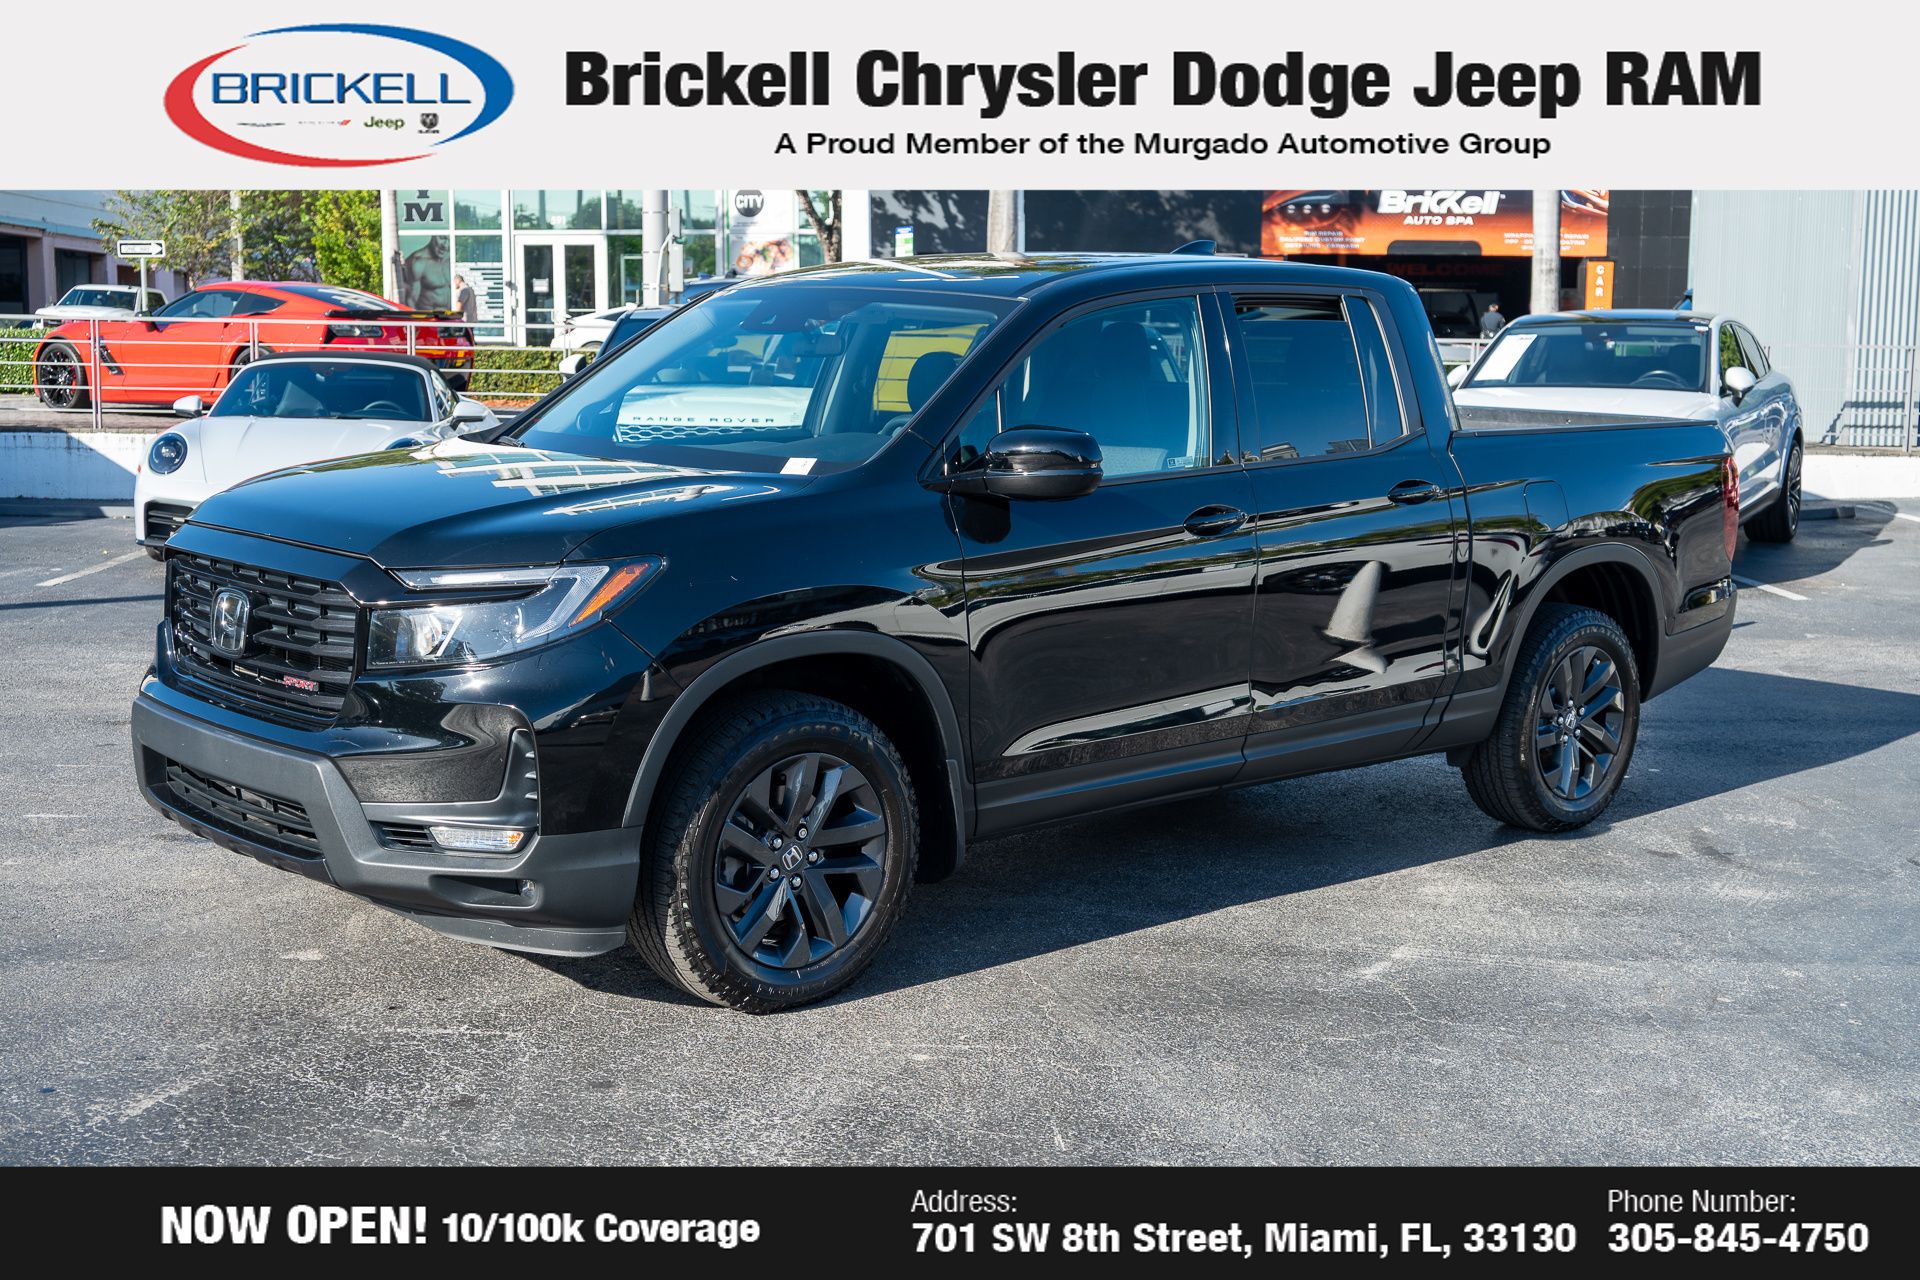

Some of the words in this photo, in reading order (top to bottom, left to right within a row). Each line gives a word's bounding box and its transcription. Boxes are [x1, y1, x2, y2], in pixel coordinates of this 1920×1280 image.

[736, 194, 763, 209] CITY
[1403, 215, 1443, 225] AUTO
[1445, 215, 1474, 225] SPA
